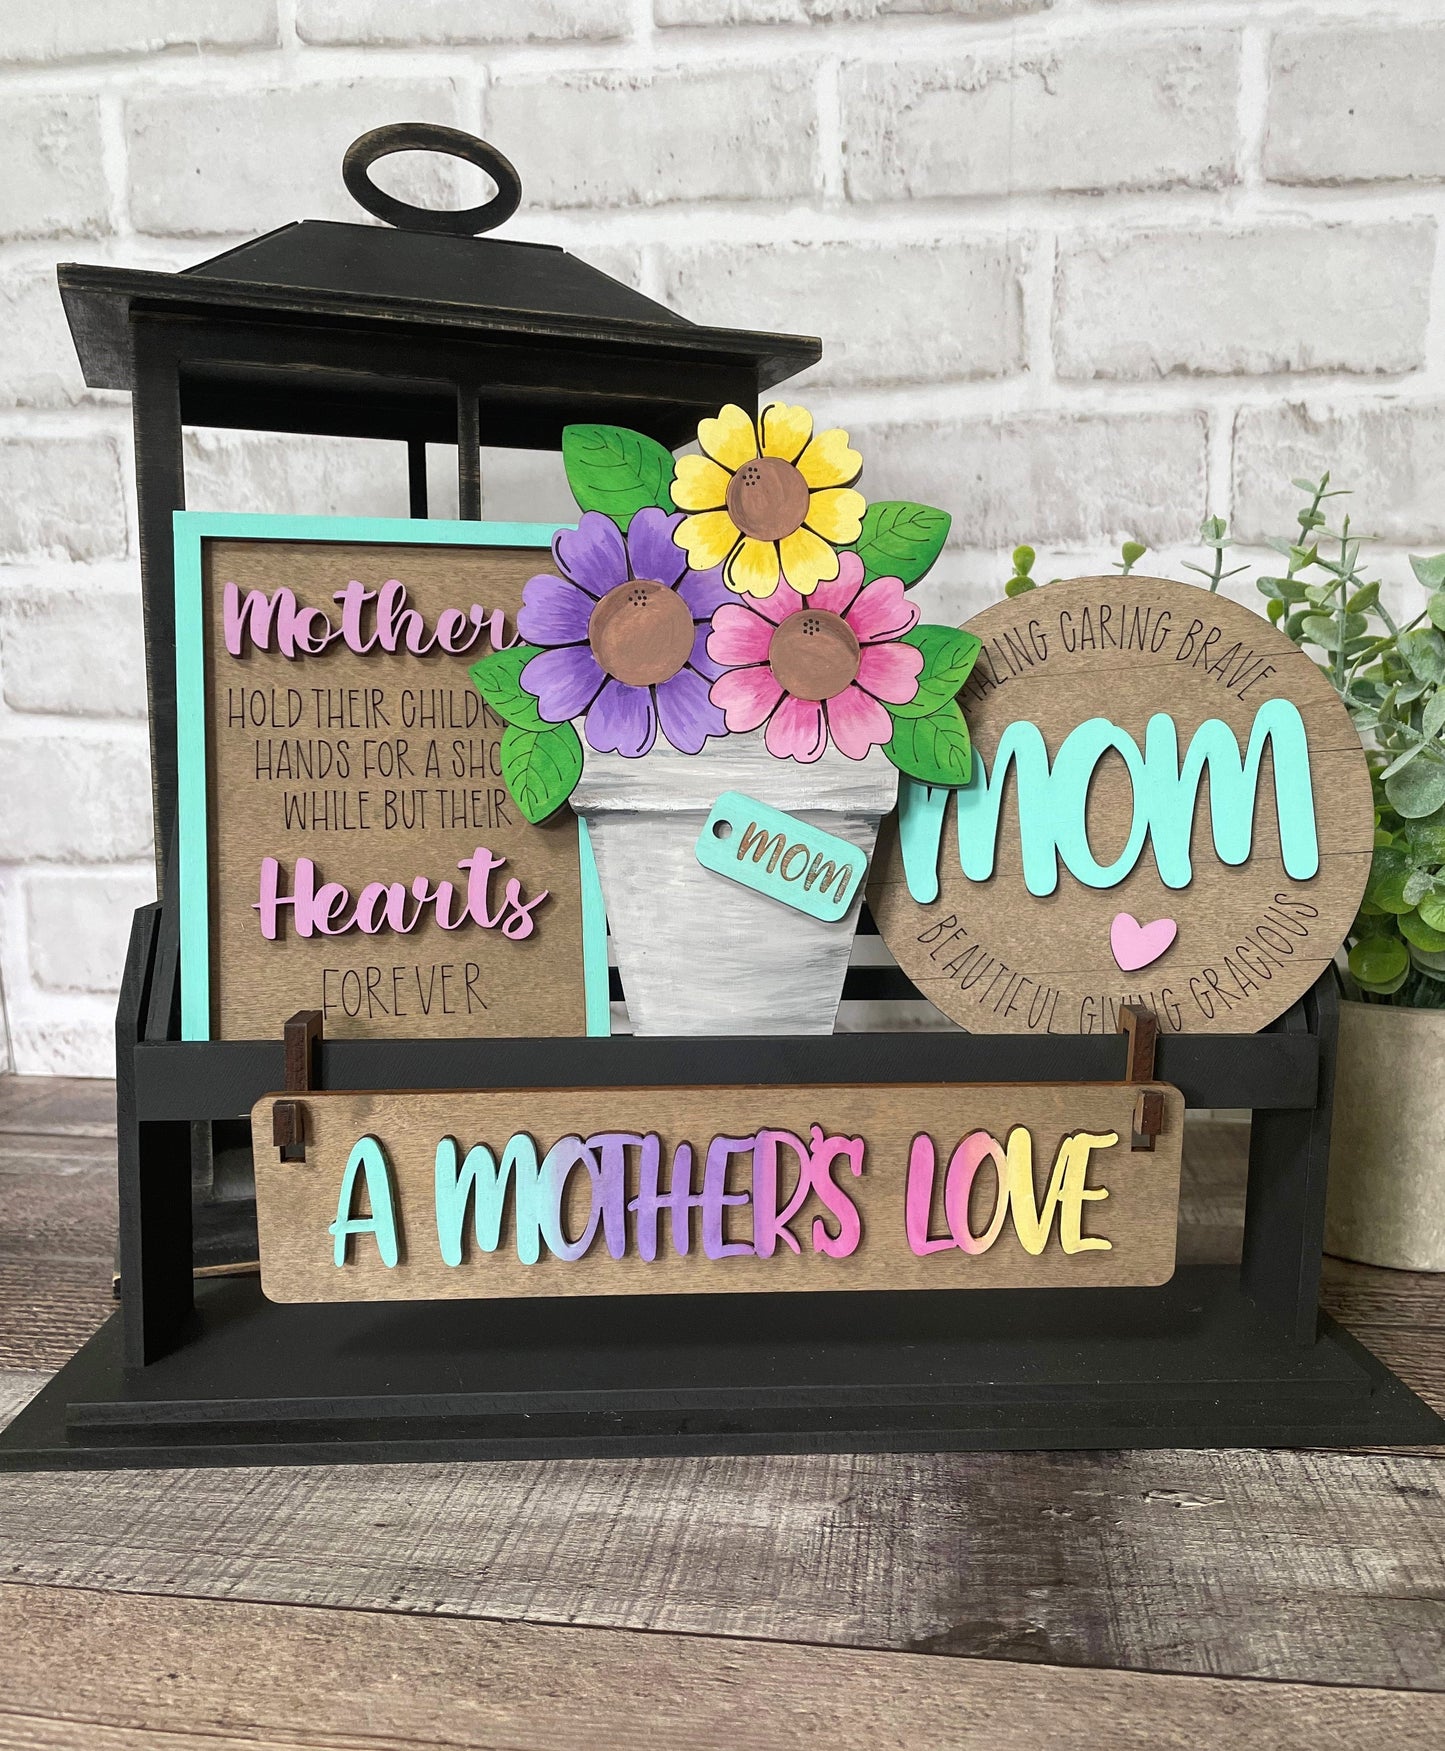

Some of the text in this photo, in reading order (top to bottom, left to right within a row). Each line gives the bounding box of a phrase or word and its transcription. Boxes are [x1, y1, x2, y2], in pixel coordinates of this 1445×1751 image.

[223, 578, 528, 658] Mother
[1059, 604, 1171, 653] CARING
[1175, 619, 1277, 701] BRAVE
[228, 687, 508, 729] HOLD THEIR CHILDR
[255, 739, 503, 780] HANDS FOR A SHO
[284, 788, 512, 831] WHILE BUT THEIR
[251, 846, 550, 941] Hearts
[322, 962, 488, 1020] FOREVER
[1189, 893, 1319, 1019] GRACIOUS
[328, 1122, 1120, 1268] A MOTHER'S LOVE
